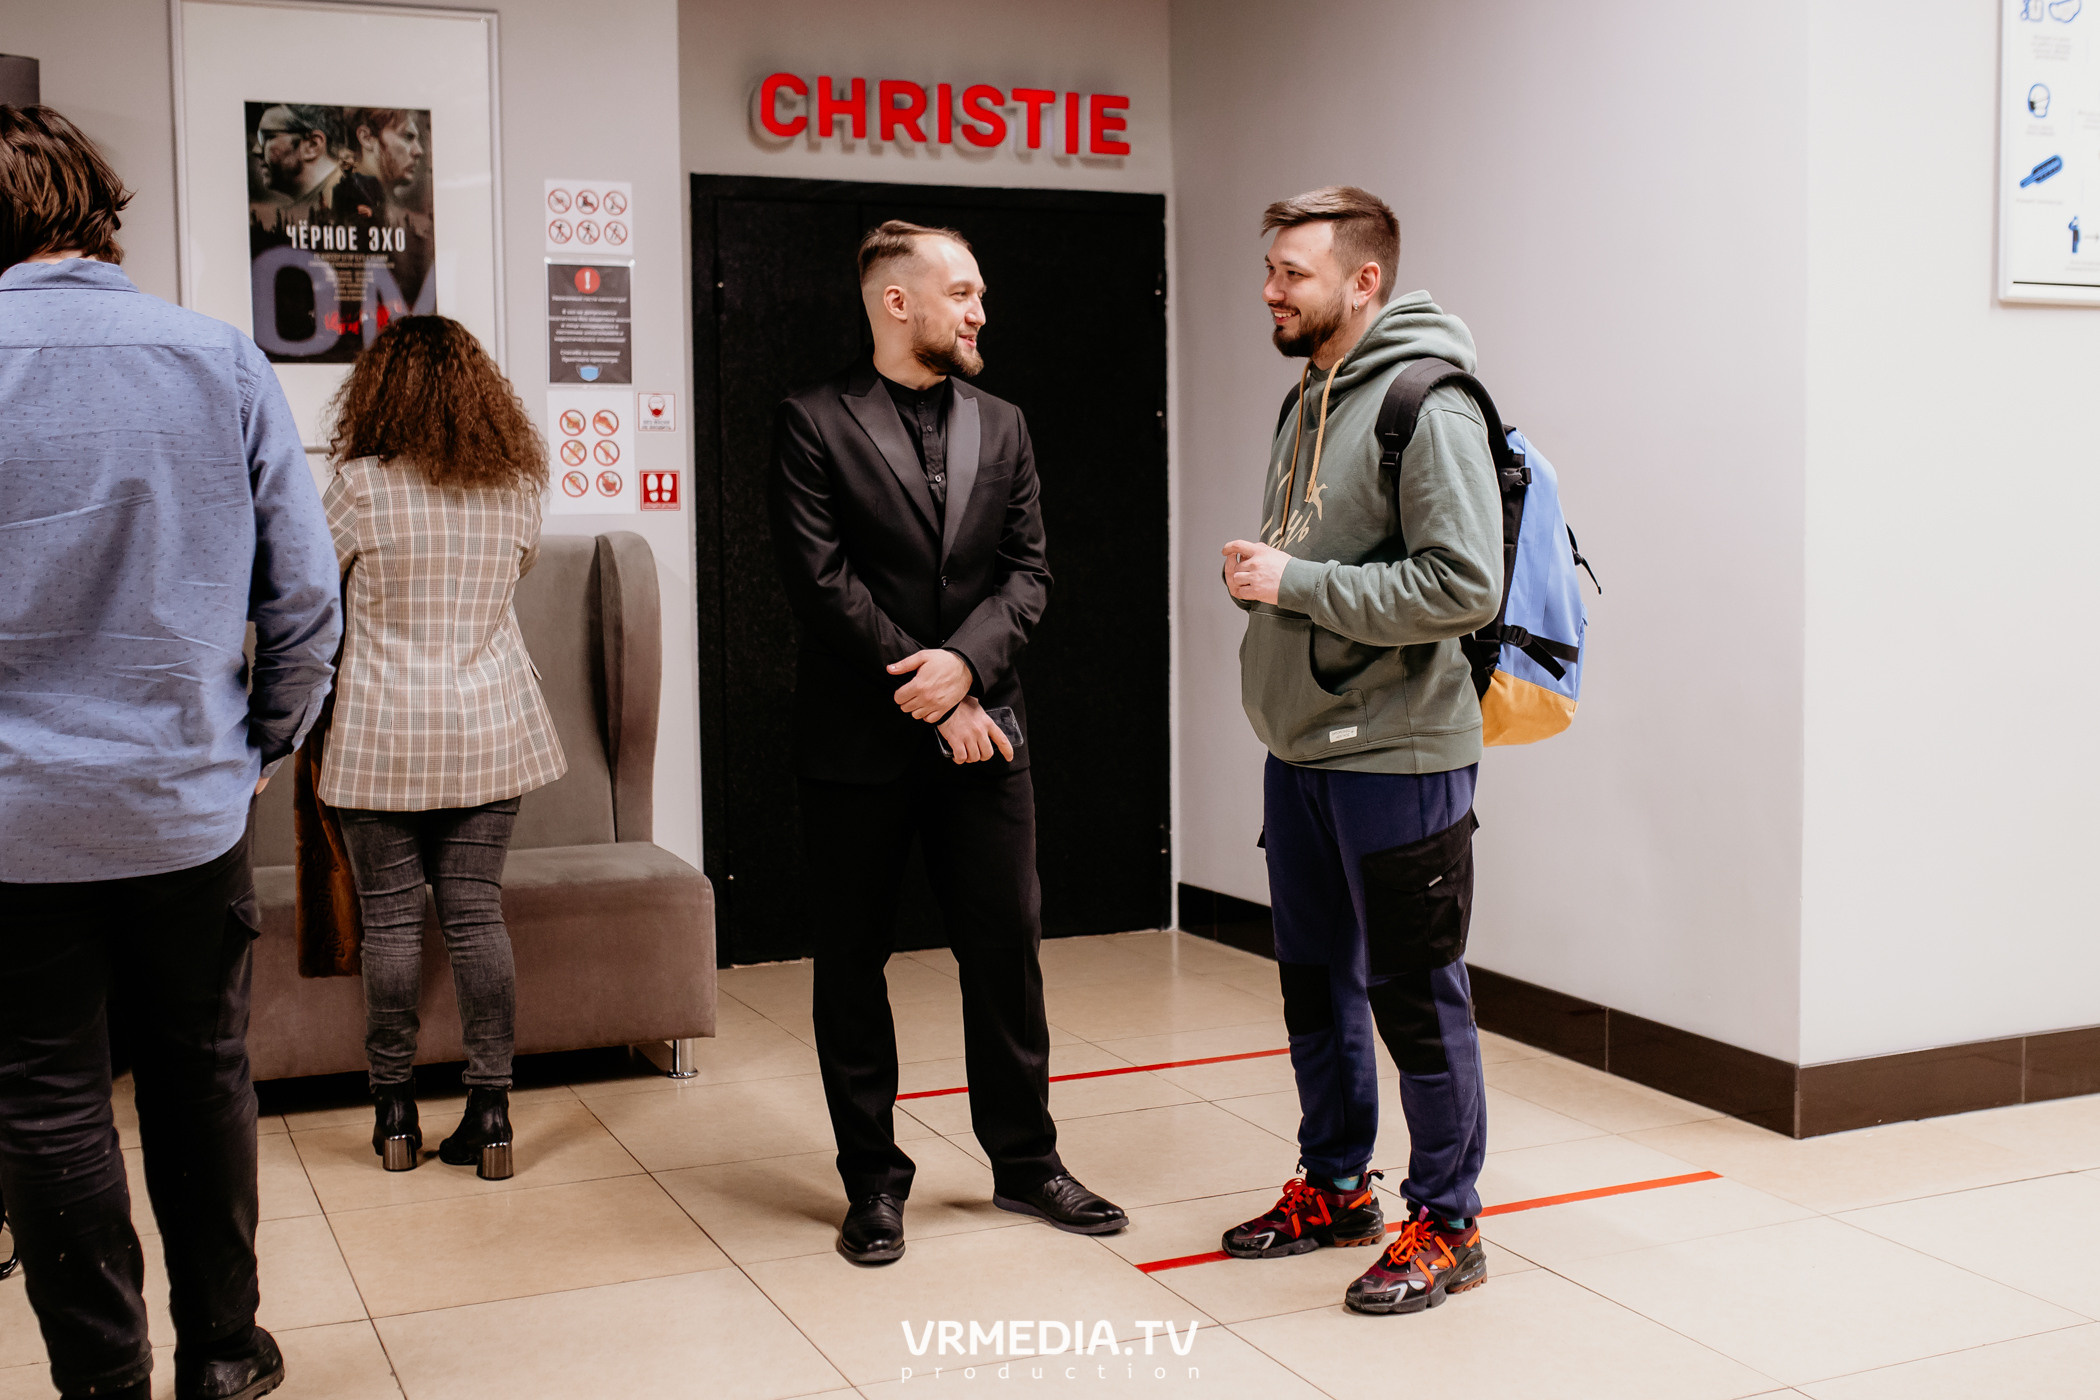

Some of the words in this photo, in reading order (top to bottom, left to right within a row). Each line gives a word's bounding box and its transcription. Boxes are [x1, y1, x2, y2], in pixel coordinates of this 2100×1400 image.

[760, 72, 1130, 155] CHRISTIE
[286, 220, 358, 251] ЧЁРНОЕ
[368, 227, 406, 252] ЭХО
